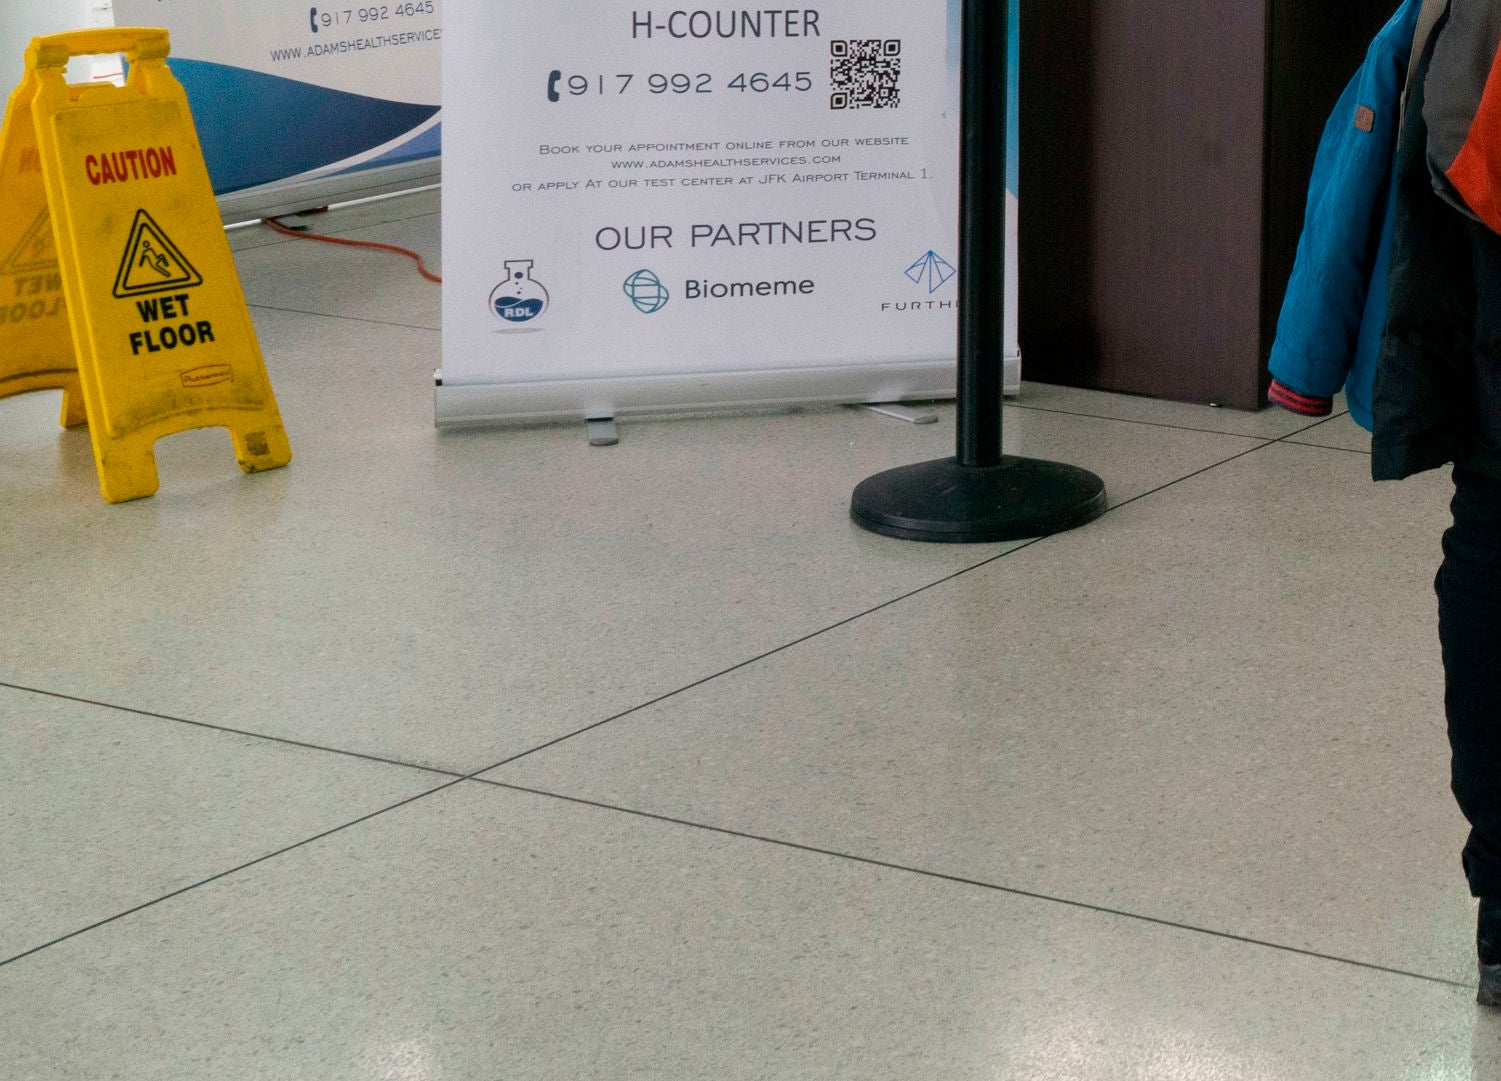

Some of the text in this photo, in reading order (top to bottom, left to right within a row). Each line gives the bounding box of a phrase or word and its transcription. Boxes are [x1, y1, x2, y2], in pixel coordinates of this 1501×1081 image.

[321, 0, 434, 27] 917 992 4645
[632, 9, 821, 39] H-COUNTER
[568, 71, 812, 96] 917 992 4645
[539, 137, 909, 155] BOOK YOUR APPOINTMENT ONLINE FROM OUR WEBSITE
[85, 146, 176, 185] CAUTION
[611, 155, 841, 169] WWW.ADAMSHEALTHSERVICES.COM
[512, 183, 532, 192] OR
[538, 181, 579, 191] APPLY
[585, 179, 603, 189] AT
[608, 180, 638, 188] OUR
[643, 178, 676, 187] TEST
[681, 177, 733, 187] CENTER
[739, 176, 754, 185] AT
[758, 174, 787, 184] JFK
[792, 173, 849, 183] AIRPORT
[854, 170, 915, 181] TERMINAL
[595, 217, 877, 251] OUR PARTNERS
[136, 293, 189, 323] WET
[504, 277, 815, 318] RDL Biomeme
[881, 300, 959, 311] FURTH
[129, 320, 215, 356] FLOOR
